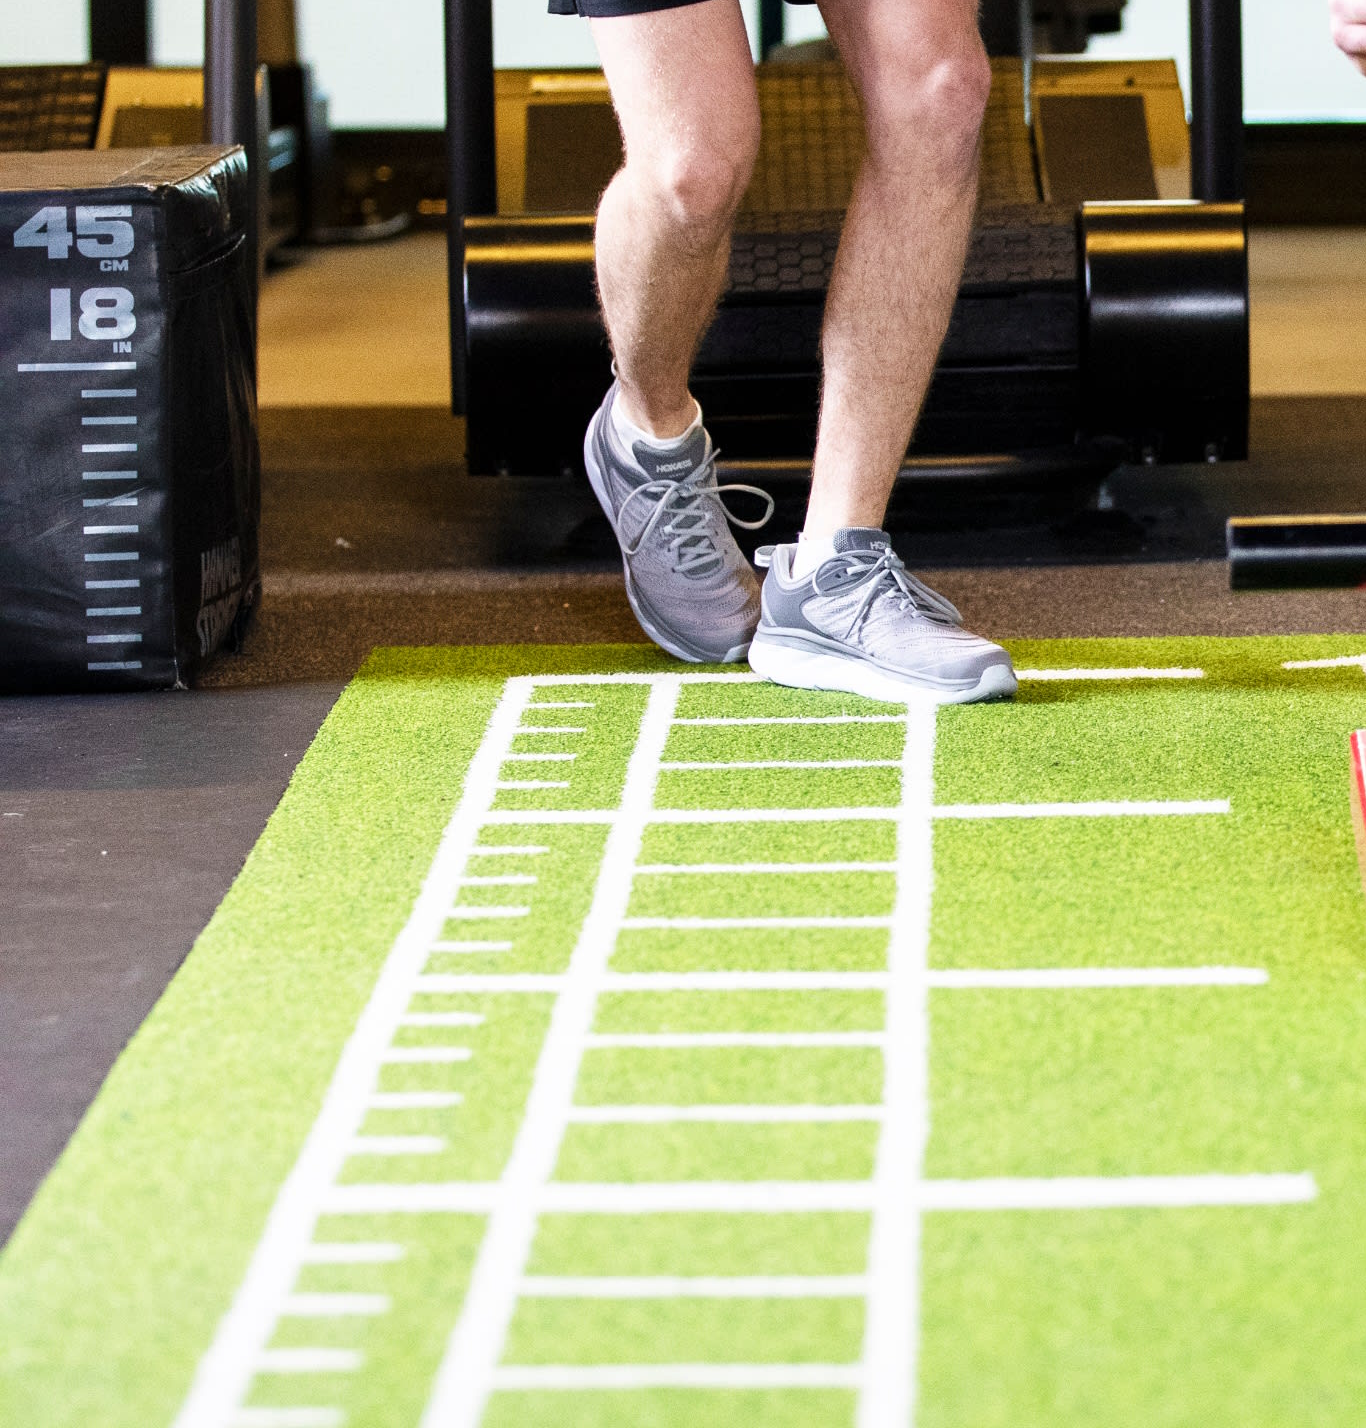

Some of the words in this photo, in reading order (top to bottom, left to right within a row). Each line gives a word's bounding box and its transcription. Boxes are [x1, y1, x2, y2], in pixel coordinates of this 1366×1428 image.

[13, 205, 135, 259] 45
[100, 259, 129, 271] CM
[50, 286, 137, 341] 18
[113, 341, 132, 353] IN
[870, 541, 890, 550] HO
